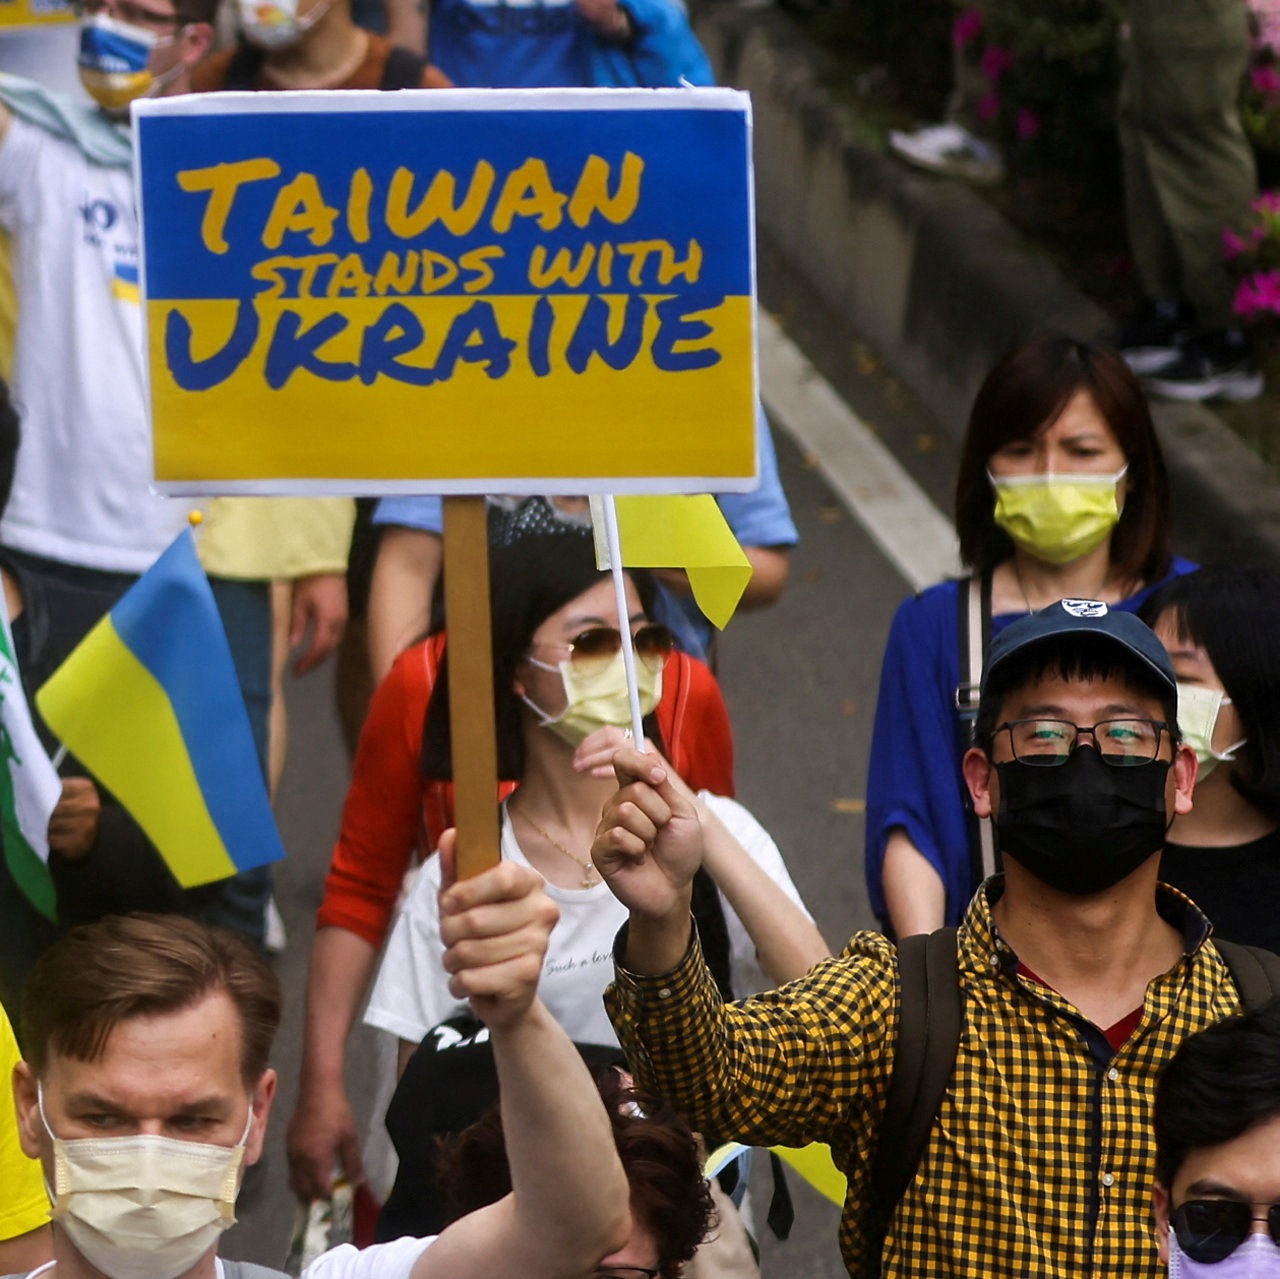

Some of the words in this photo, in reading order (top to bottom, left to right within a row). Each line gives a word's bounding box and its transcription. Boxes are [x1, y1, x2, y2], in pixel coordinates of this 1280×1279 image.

[176, 150, 645, 254] TAIWAN
[250, 244, 505, 299] STANDS
[528, 237, 704, 289] WITH
[165, 294, 726, 391] UKRAINE
